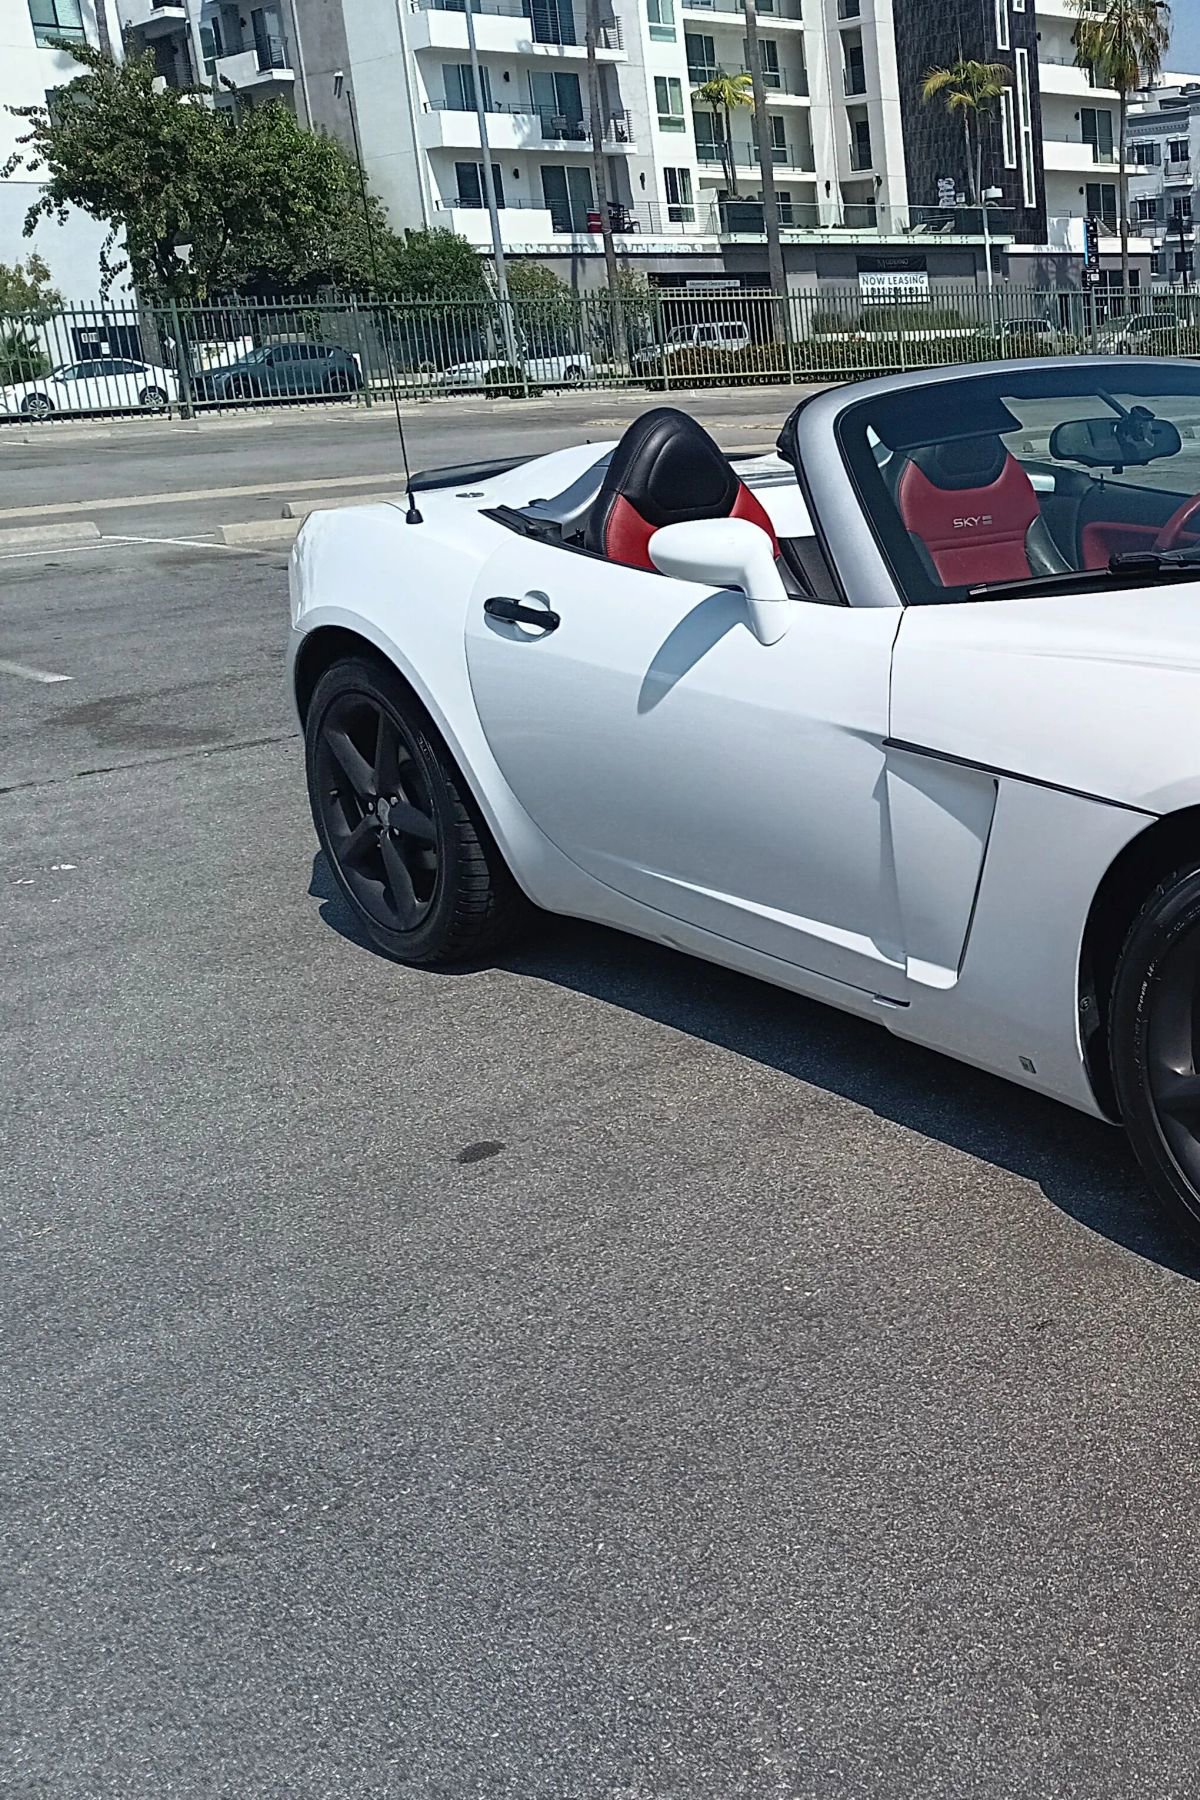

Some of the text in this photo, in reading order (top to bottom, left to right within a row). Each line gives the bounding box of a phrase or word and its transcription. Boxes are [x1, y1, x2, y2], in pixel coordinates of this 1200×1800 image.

[862, 275, 925, 286] NOW LEASING
[953, 515, 981, 529] SKY
